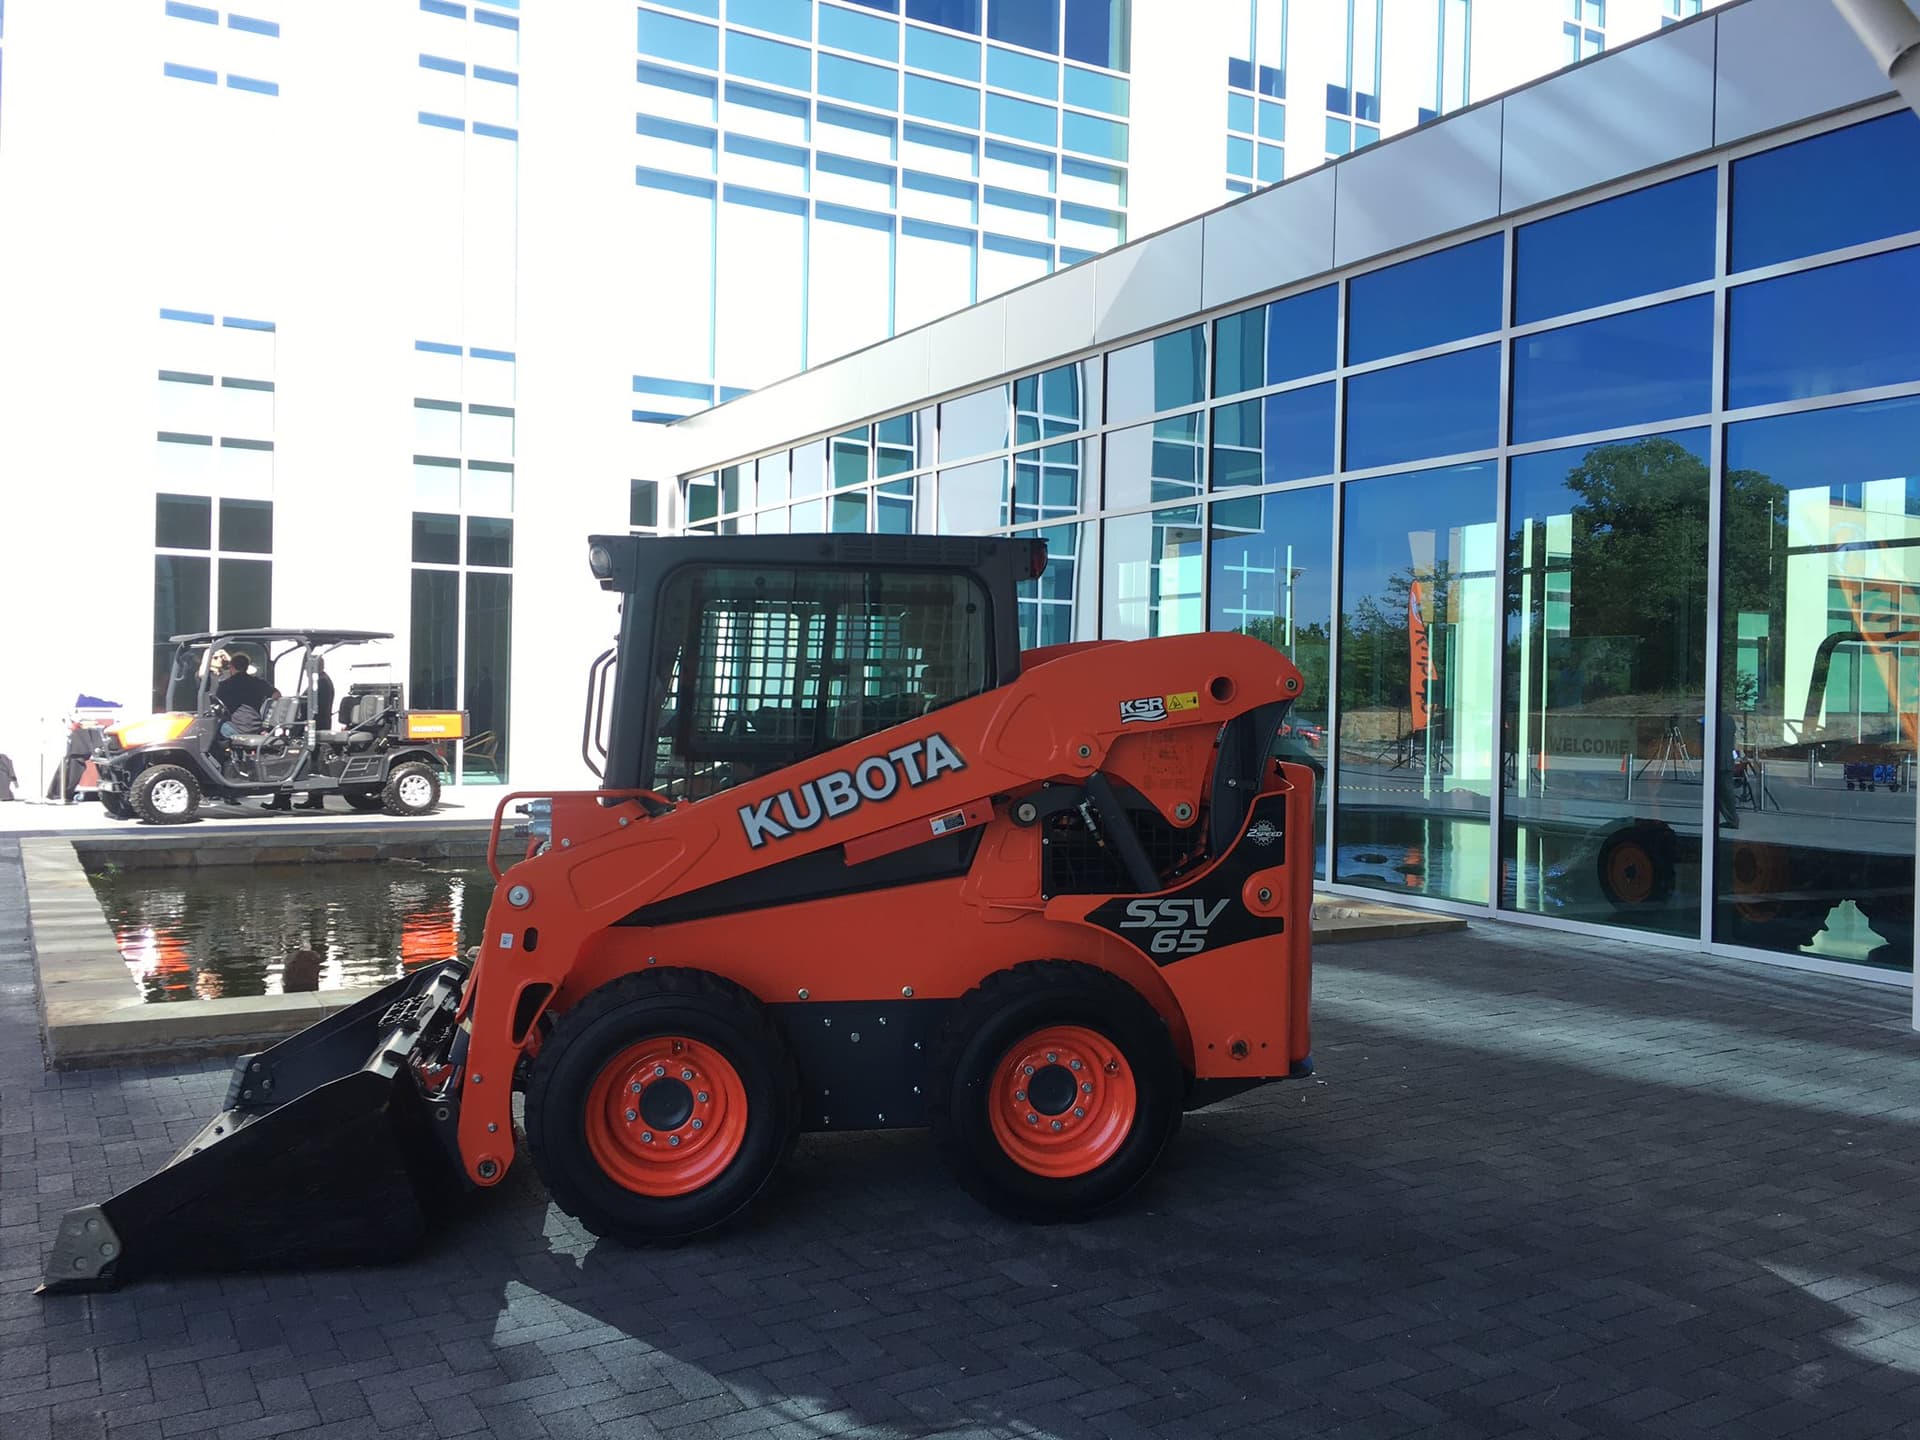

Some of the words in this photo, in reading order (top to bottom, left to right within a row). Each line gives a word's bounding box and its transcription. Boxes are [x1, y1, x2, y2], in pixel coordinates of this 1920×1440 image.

[1120, 697, 1164, 713] KSR
[1549, 736, 1629, 754] WELCOME
[738, 732, 967, 848] KUBOTA
[1120, 898, 1231, 928] SSV
[1150, 929, 1208, 953] 65
